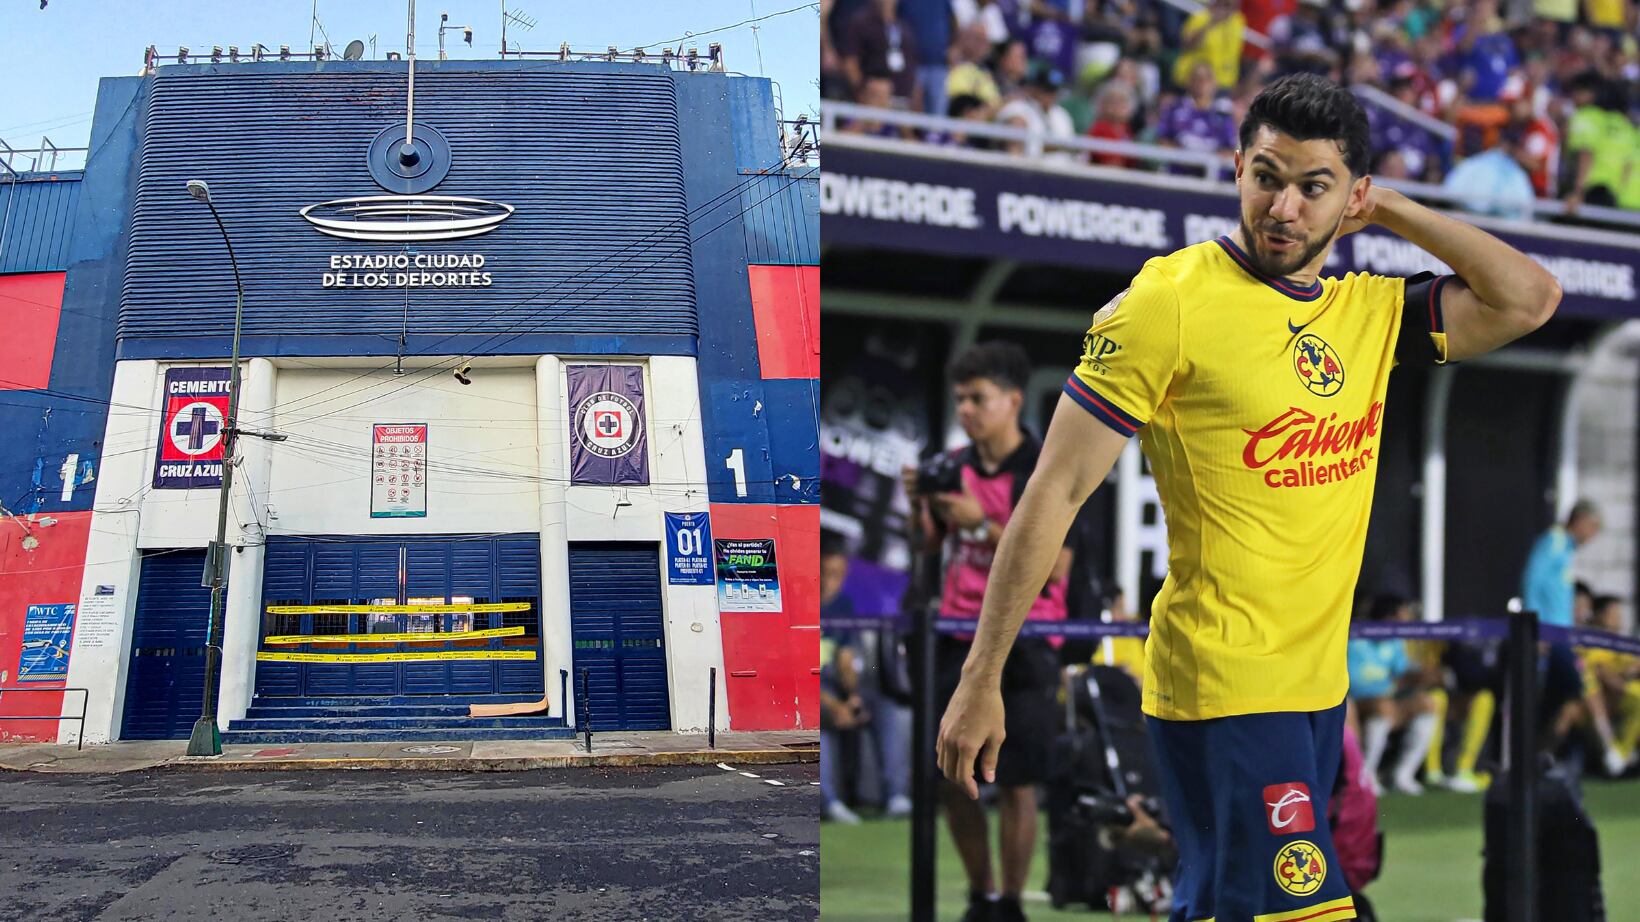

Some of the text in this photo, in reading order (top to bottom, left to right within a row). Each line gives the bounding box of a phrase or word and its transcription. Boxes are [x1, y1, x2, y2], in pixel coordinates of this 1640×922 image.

[998, 192, 1169, 249] POWERADE
[330, 254, 485, 269] ESTADIO CIUDAD
[322, 272, 492, 287] DE LOS DEPORTES
[380, 435, 419, 443] PROHIBIDOS
[159, 465, 192, 478] CRUZ
[726, 449, 747, 497] 1
[677, 528, 703, 556] 01
[37, 606, 58, 615] WTC
